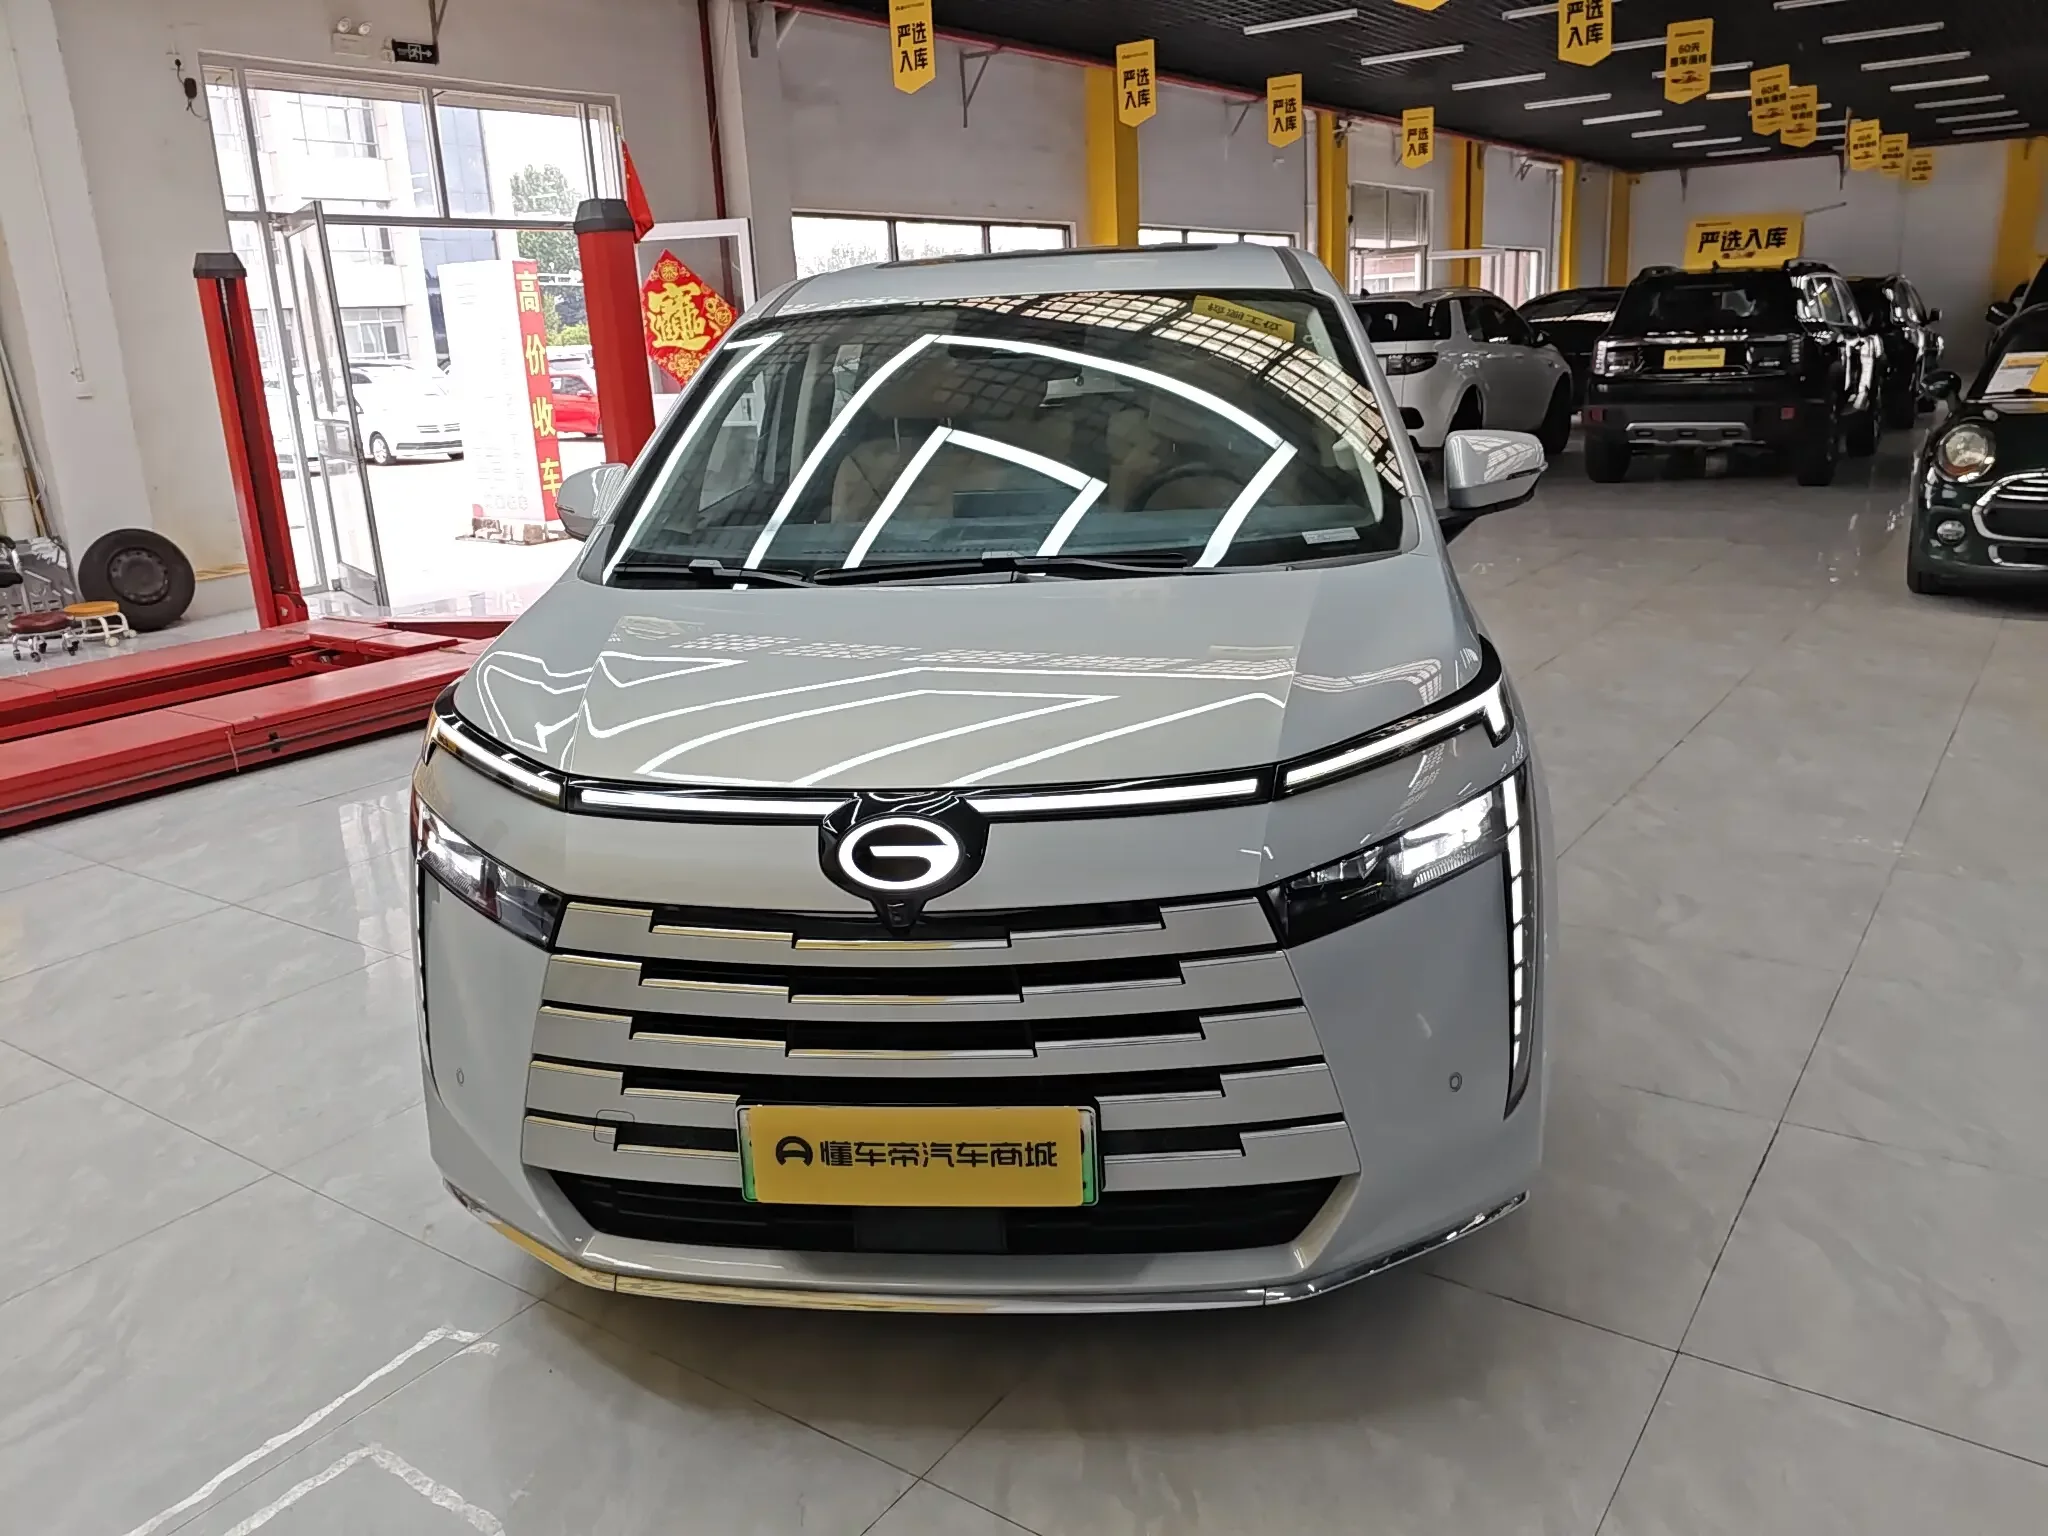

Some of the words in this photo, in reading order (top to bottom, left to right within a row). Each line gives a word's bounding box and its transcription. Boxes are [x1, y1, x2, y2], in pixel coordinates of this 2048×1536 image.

[1566, 0, 1604, 24] 严选
[896, 20, 928, 48] 严选
[1566, 22, 1605, 49] 入库
[899, 47, 929, 73] 入库
[1122, 67, 1150, 90] 严选
[1124, 88, 1151, 111] 入库
[1272, 97, 1297, 116] 严选
[1272, 115, 1298, 134] 入库
[1407, 126, 1429, 142] 严选
[1406, 141, 1429, 157] 入库
[1697, 226, 1789, 254] 严选入库
[514, 270, 563, 496] 高价收车
[819, 1140, 1059, 1168] 懂车帝汽车商城
